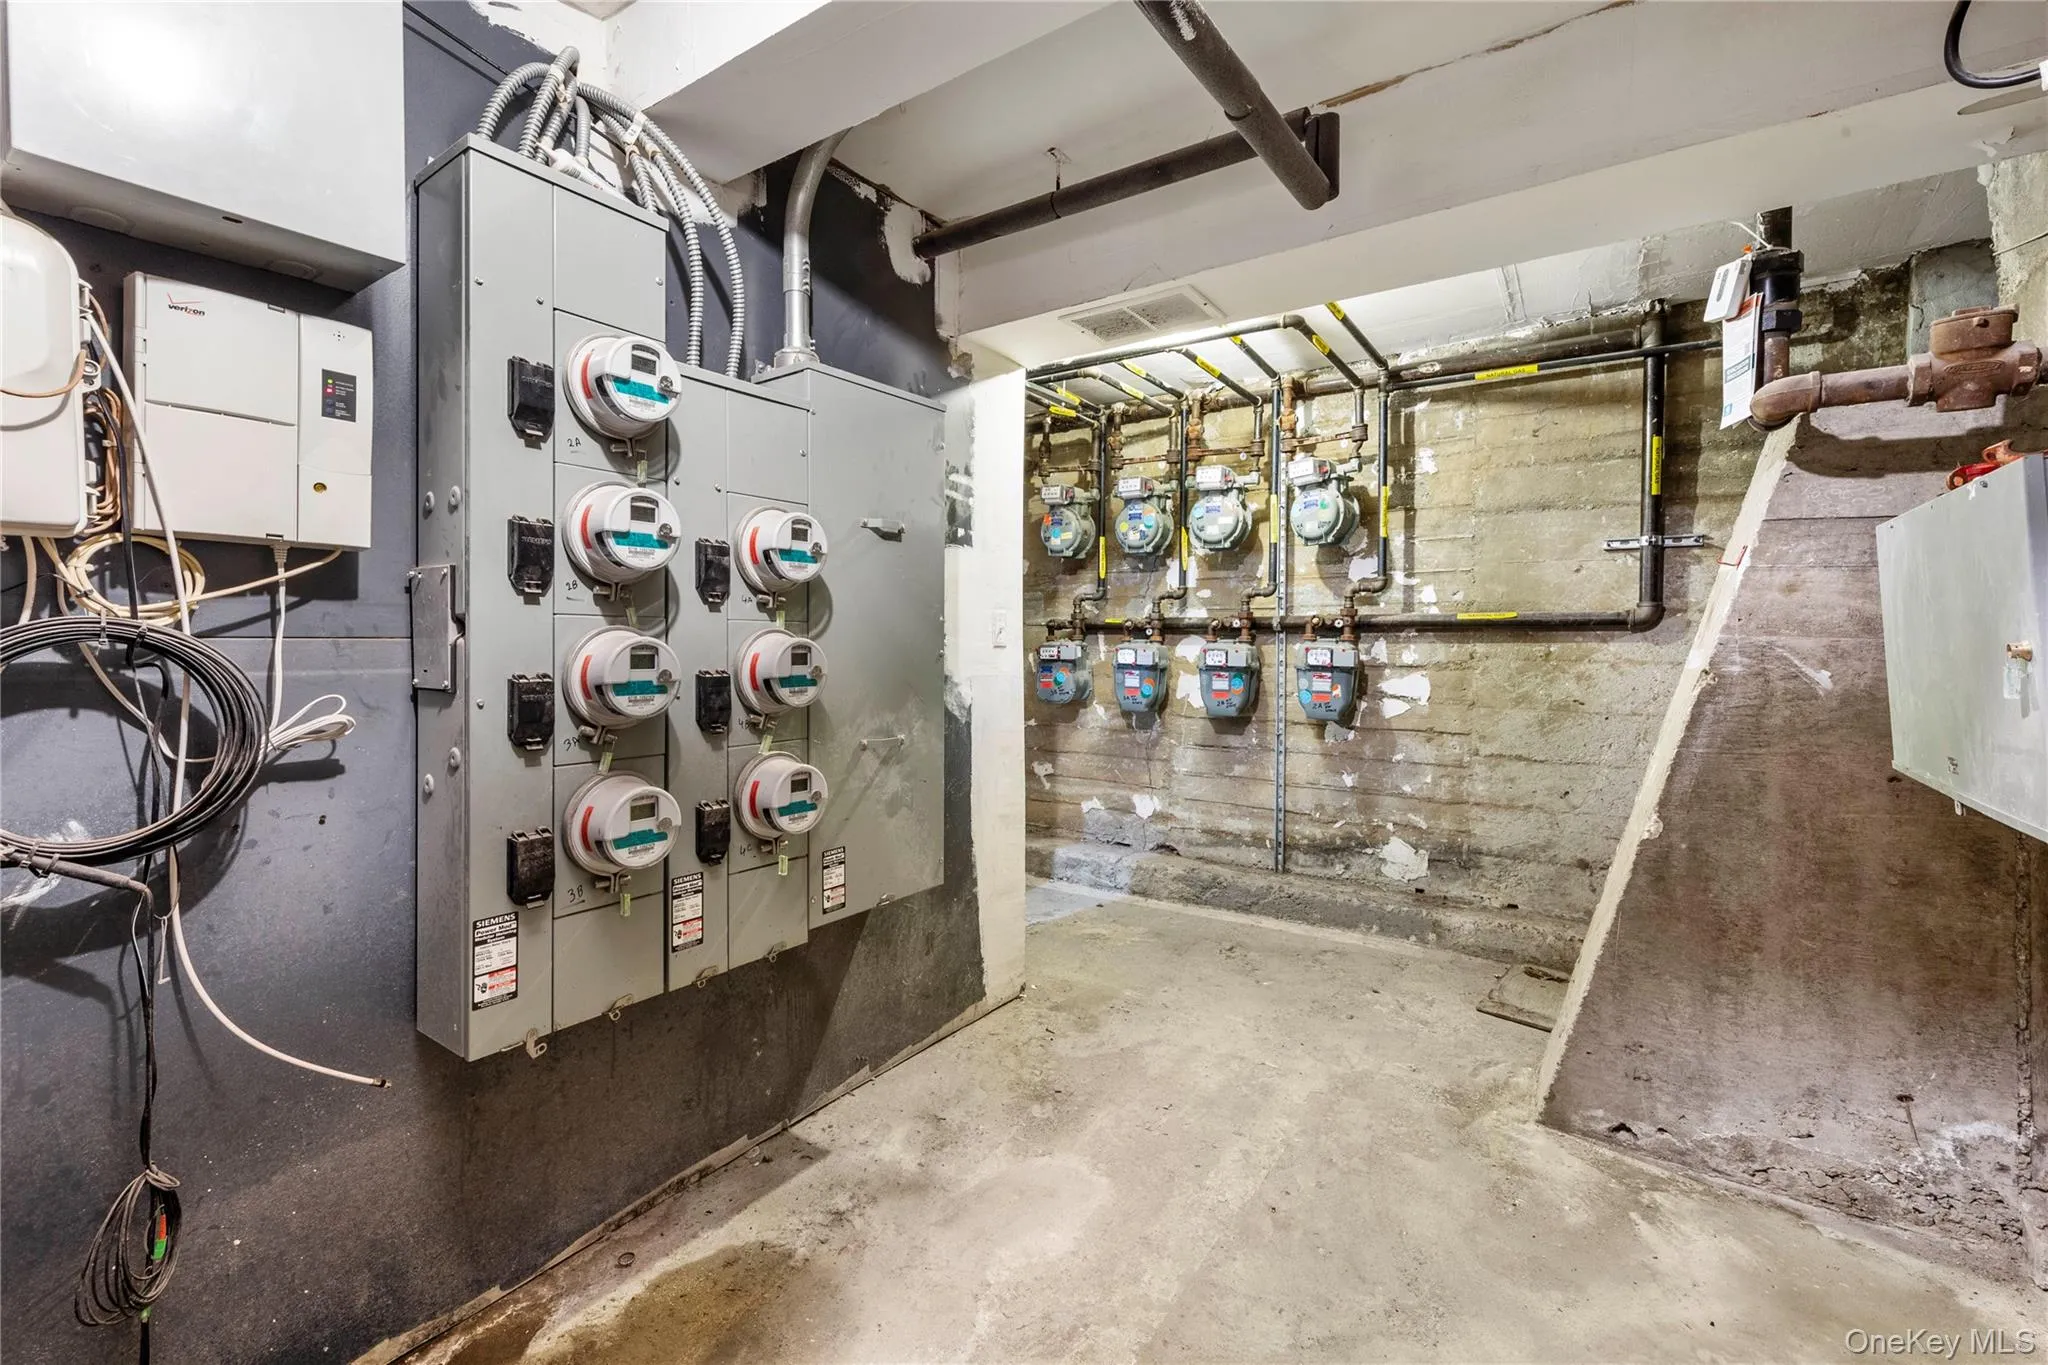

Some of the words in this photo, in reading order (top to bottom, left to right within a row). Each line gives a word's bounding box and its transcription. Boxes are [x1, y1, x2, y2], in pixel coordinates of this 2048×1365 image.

[168, 304, 205, 316] verizon
[1486, 370, 1512, 378] NATURAL
[567, 437, 581, 447] 2A
[673, 873, 702, 885] SIEMENS
[476, 913, 516, 928] SIEMENS
[476, 927, 497, 936] Power
